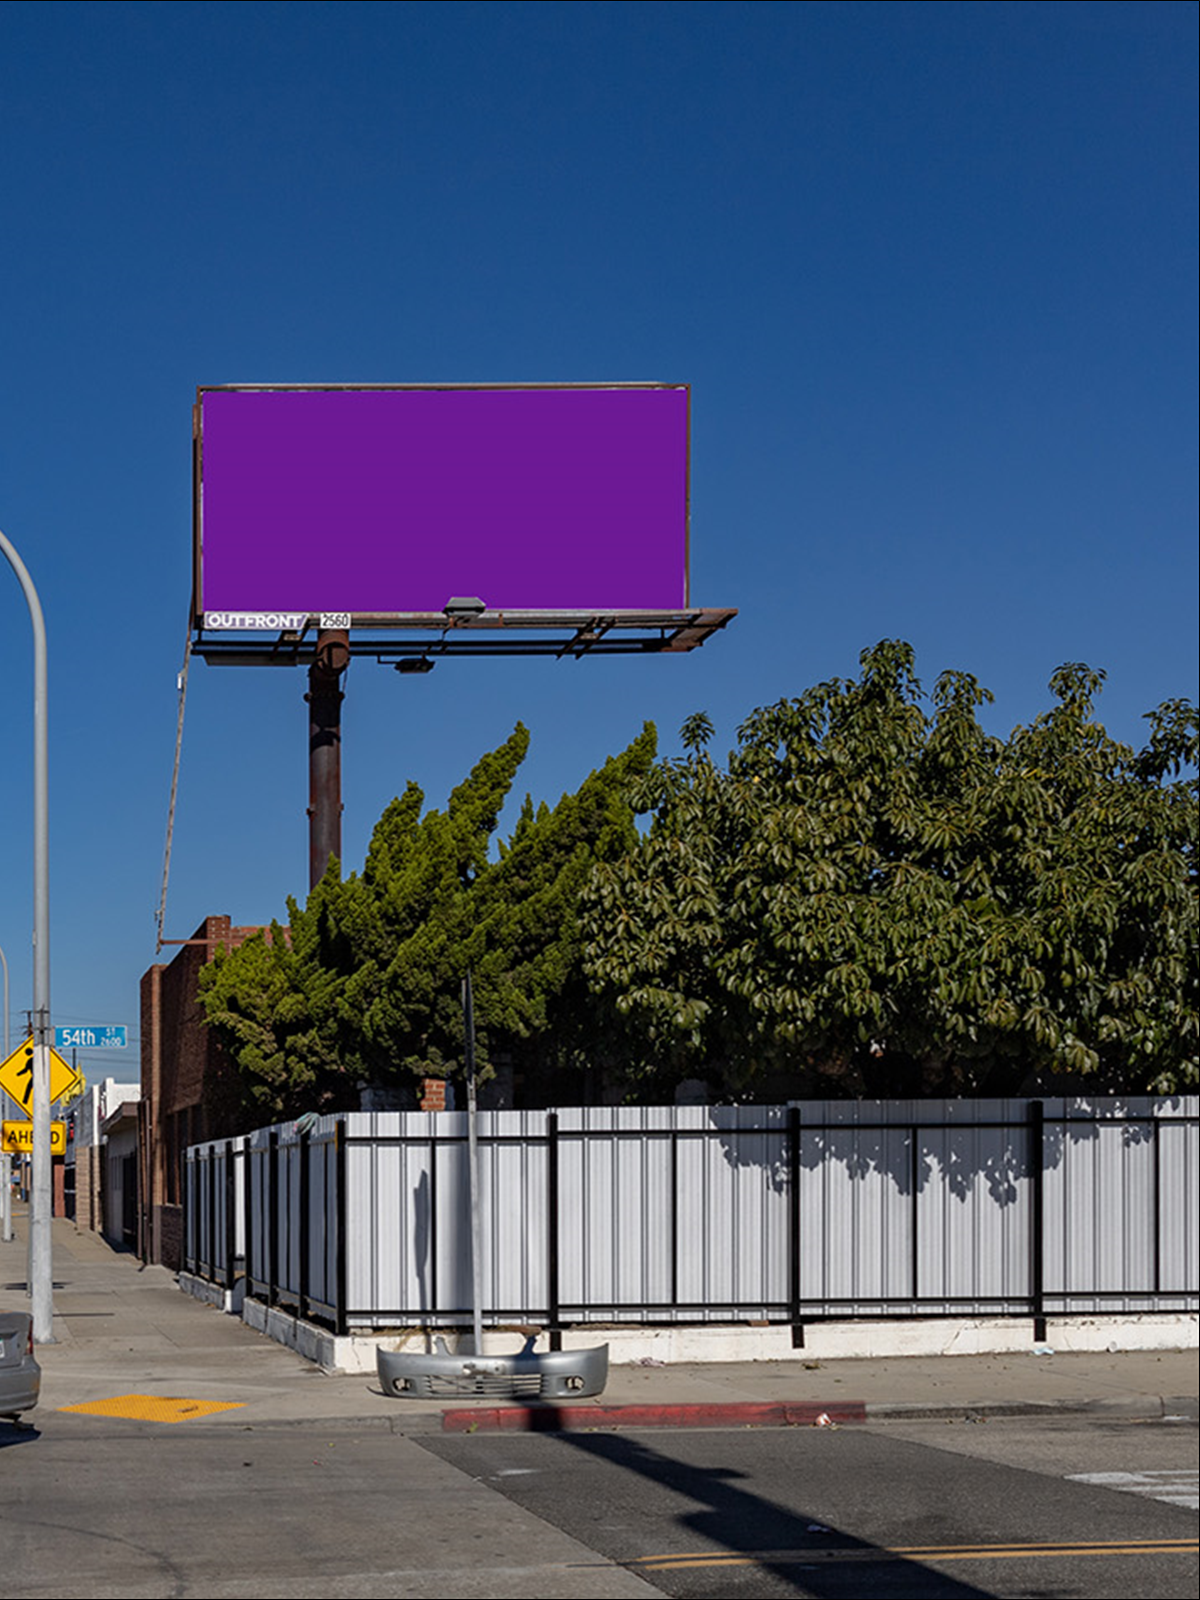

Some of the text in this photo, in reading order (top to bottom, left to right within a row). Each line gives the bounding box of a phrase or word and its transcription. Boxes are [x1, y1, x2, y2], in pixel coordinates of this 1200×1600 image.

[208, 614, 302, 628] OUTFRONT
[322, 613, 349, 627] 2560
[62, 1029, 96, 1046] 54th
[7, 1130, 60, 1145] AHD
